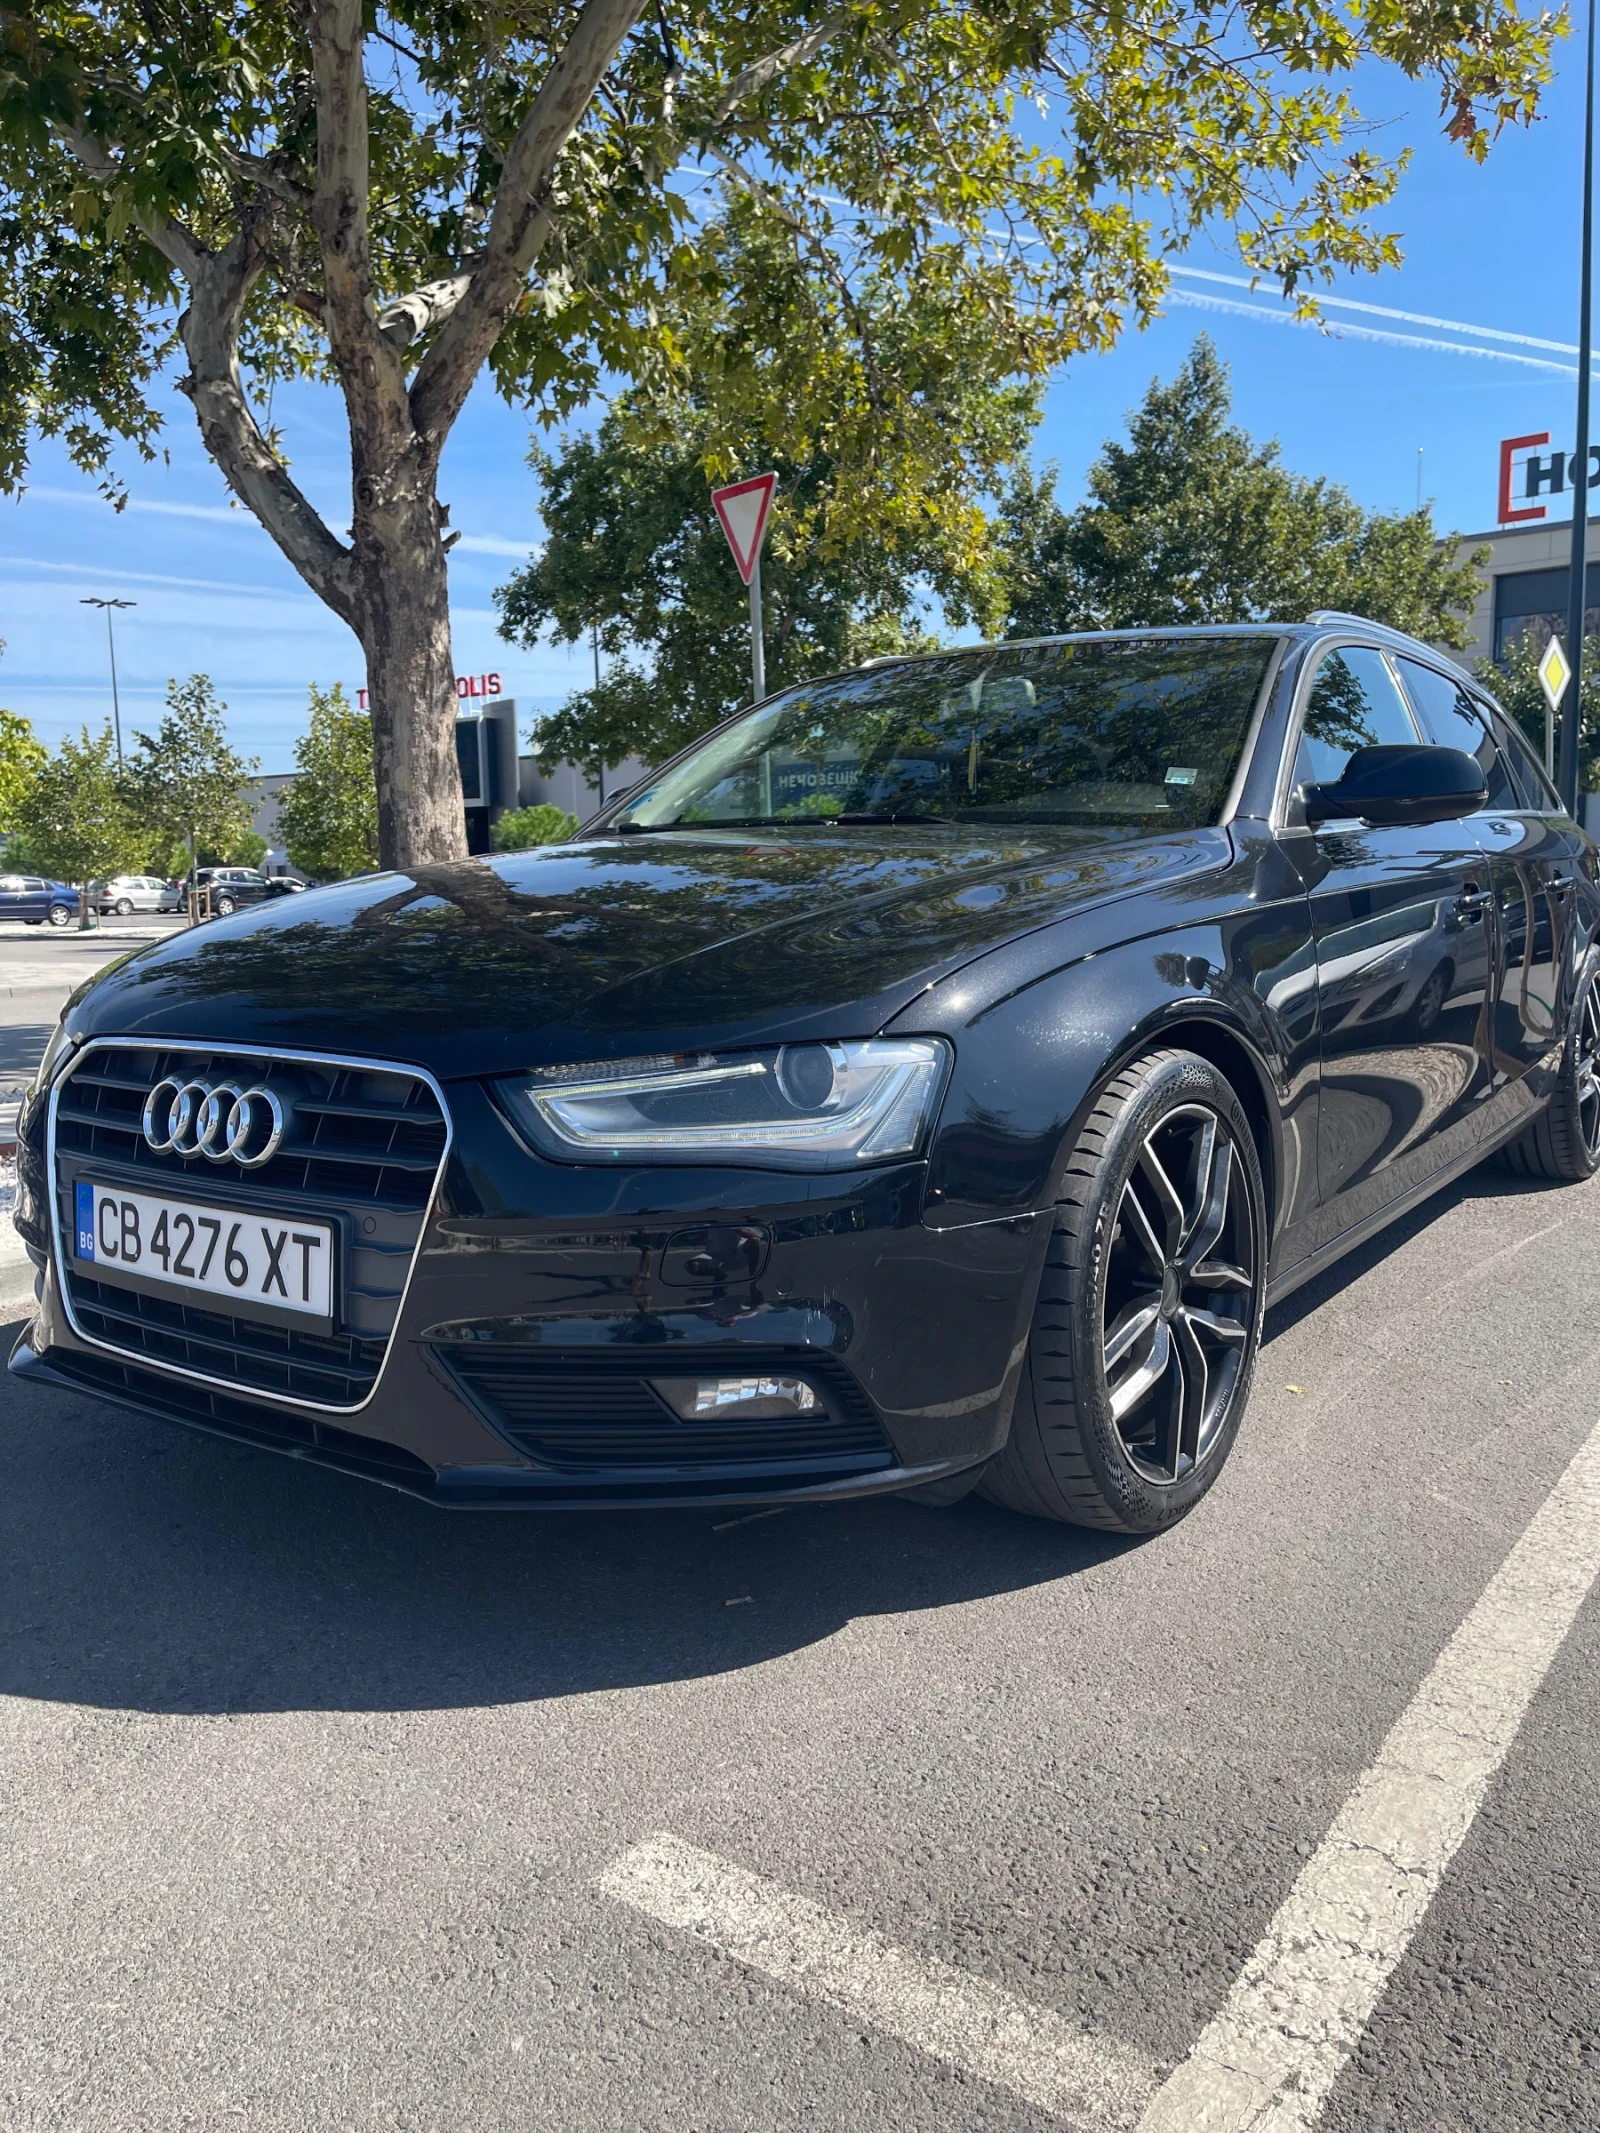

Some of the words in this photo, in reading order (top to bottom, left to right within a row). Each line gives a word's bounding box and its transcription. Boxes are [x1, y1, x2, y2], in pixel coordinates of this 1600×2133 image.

[80, 1231, 93, 1250] BG
[98, 1197, 142, 1263] CB
[150, 1209, 249, 1287] 4276
[260, 1227, 321, 1302] XT
